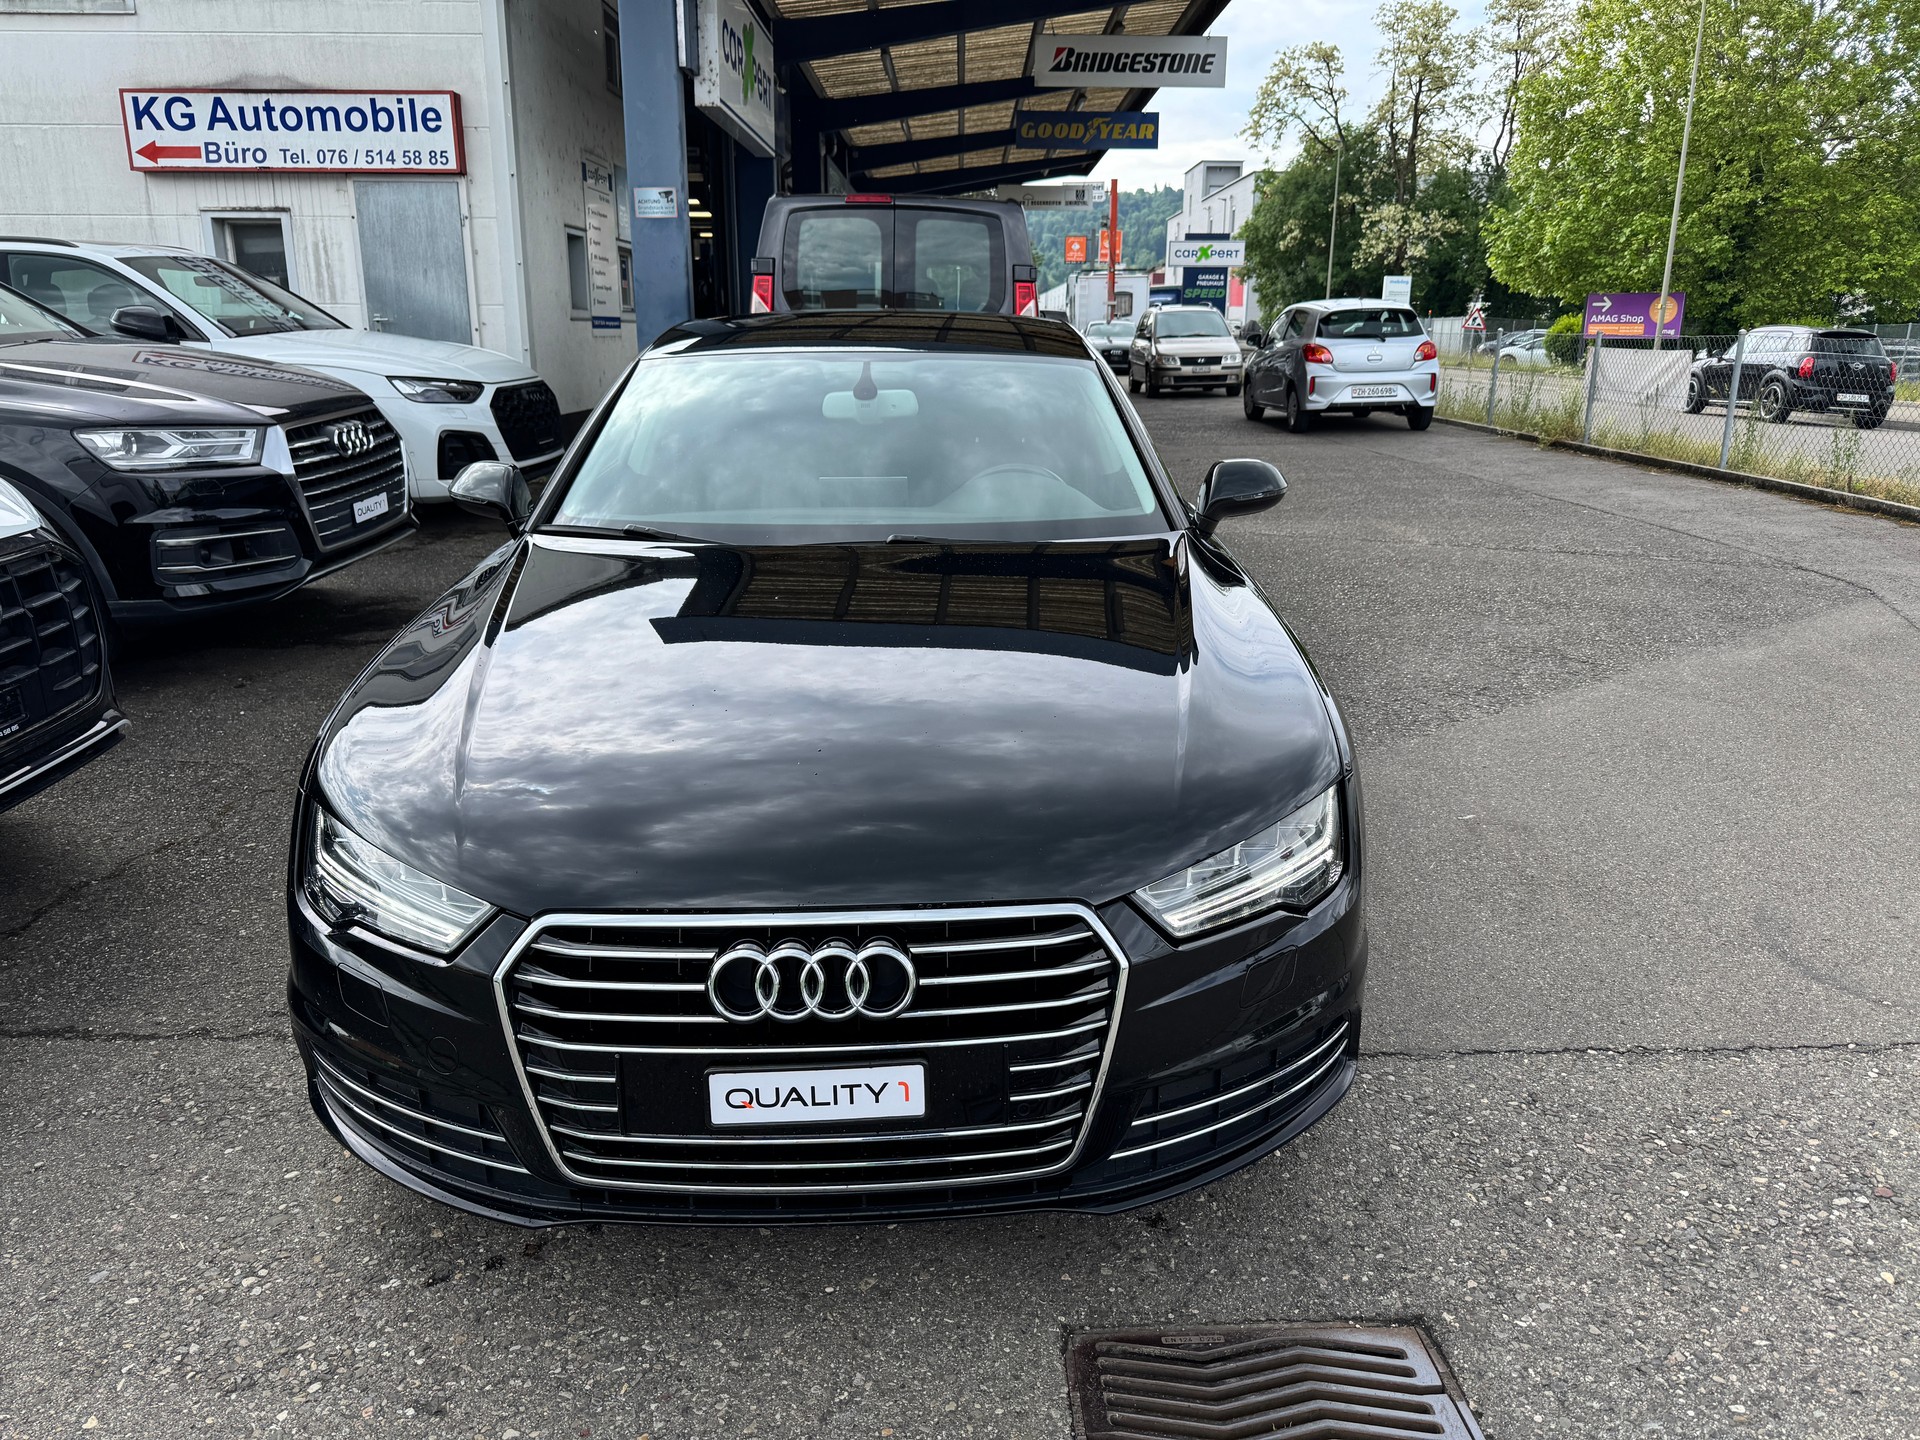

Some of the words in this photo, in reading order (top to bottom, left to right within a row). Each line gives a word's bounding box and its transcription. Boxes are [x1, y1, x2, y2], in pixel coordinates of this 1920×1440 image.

[1048, 47, 1216, 74] BRIDGESTONE
[131, 96, 196, 132] KG
[207, 96, 442, 133] Automobile
[204, 141, 267, 164] Büro
[279, 148, 310, 164] Tel.
[316, 149, 348, 165] 076
[365, 150, 396, 165] 514
[402, 150, 423, 165] 58
[428, 150, 449, 166] 85
[1183, 288, 1225, 298] SPEED
[1590, 314, 1618, 322] AMAG
[1620, 314, 1644, 324] Shop
[357, 501, 382, 516] QUALITY
[725, 1082, 888, 1109] QUALITY
[898, 1081, 910, 1102] 1
